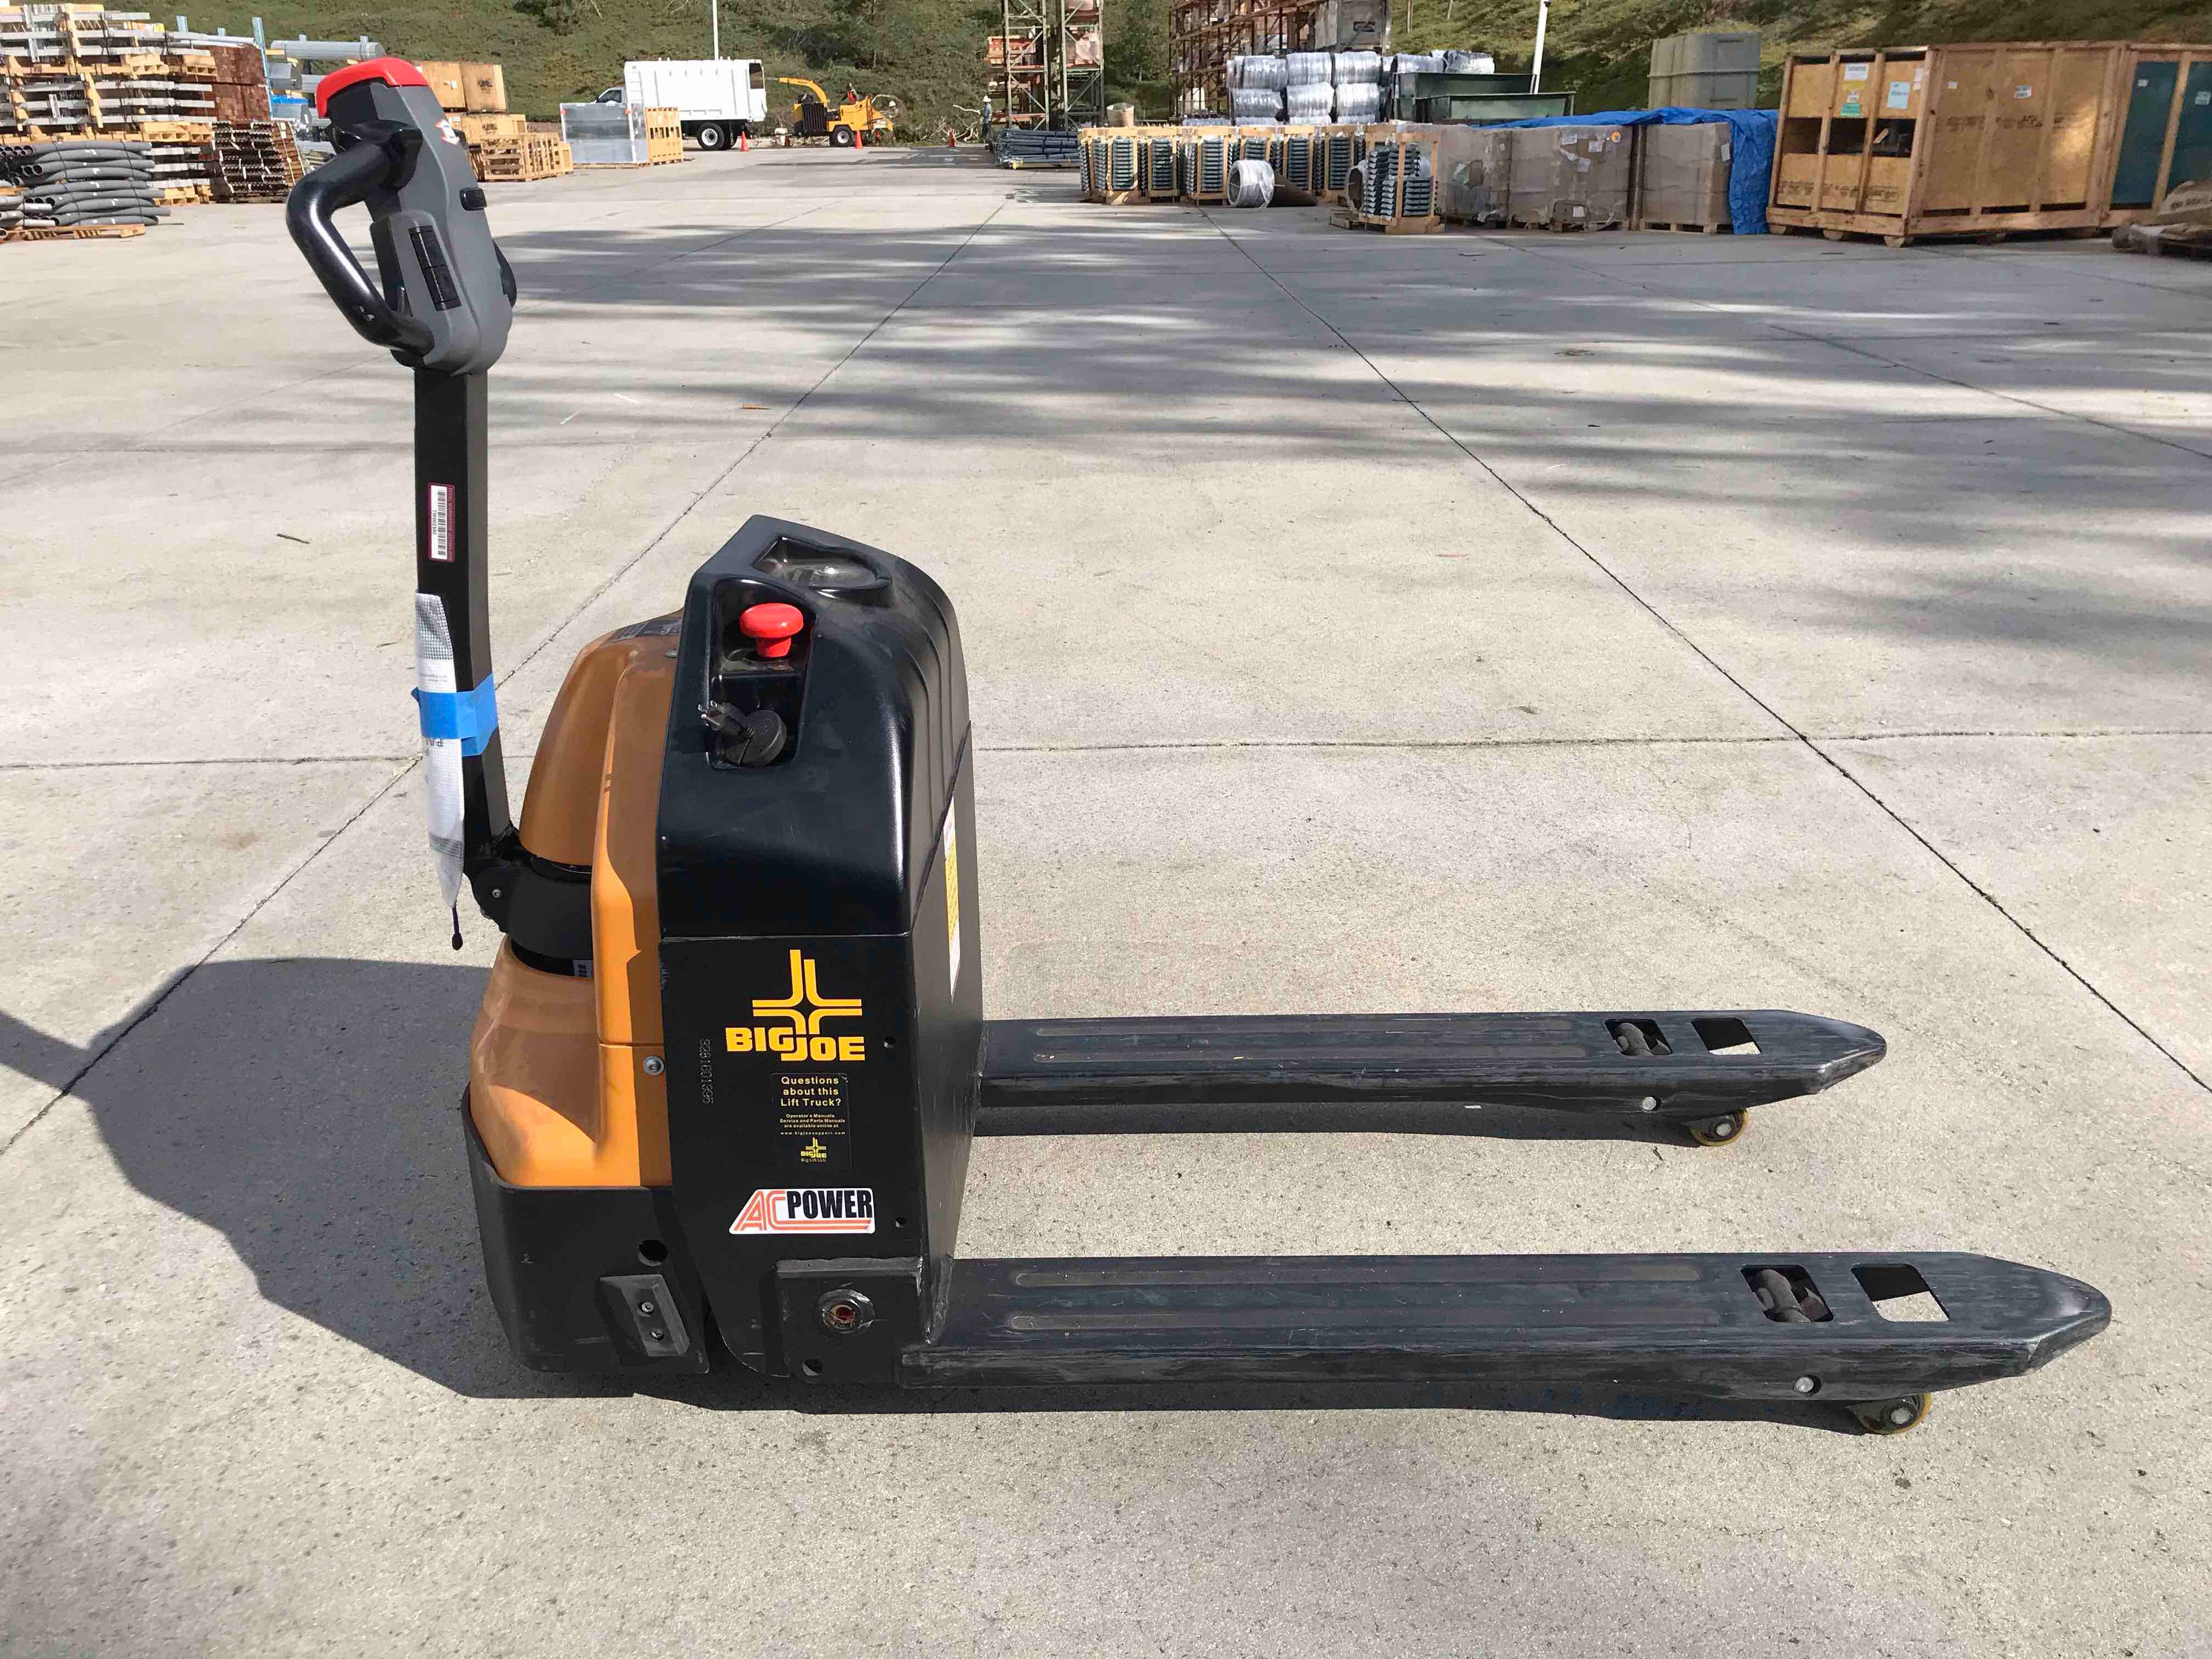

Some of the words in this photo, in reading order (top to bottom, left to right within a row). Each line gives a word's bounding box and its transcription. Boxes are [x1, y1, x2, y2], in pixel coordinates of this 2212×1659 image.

[781, 1076, 839, 1085] Questions
[783, 1087, 815, 1096] about
[817, 1087, 839, 1096] this
[781, 1099, 800, 1107] Lift
[802, 1098, 842, 1107] Truck?
[786, 1190, 873, 1219] POWER
